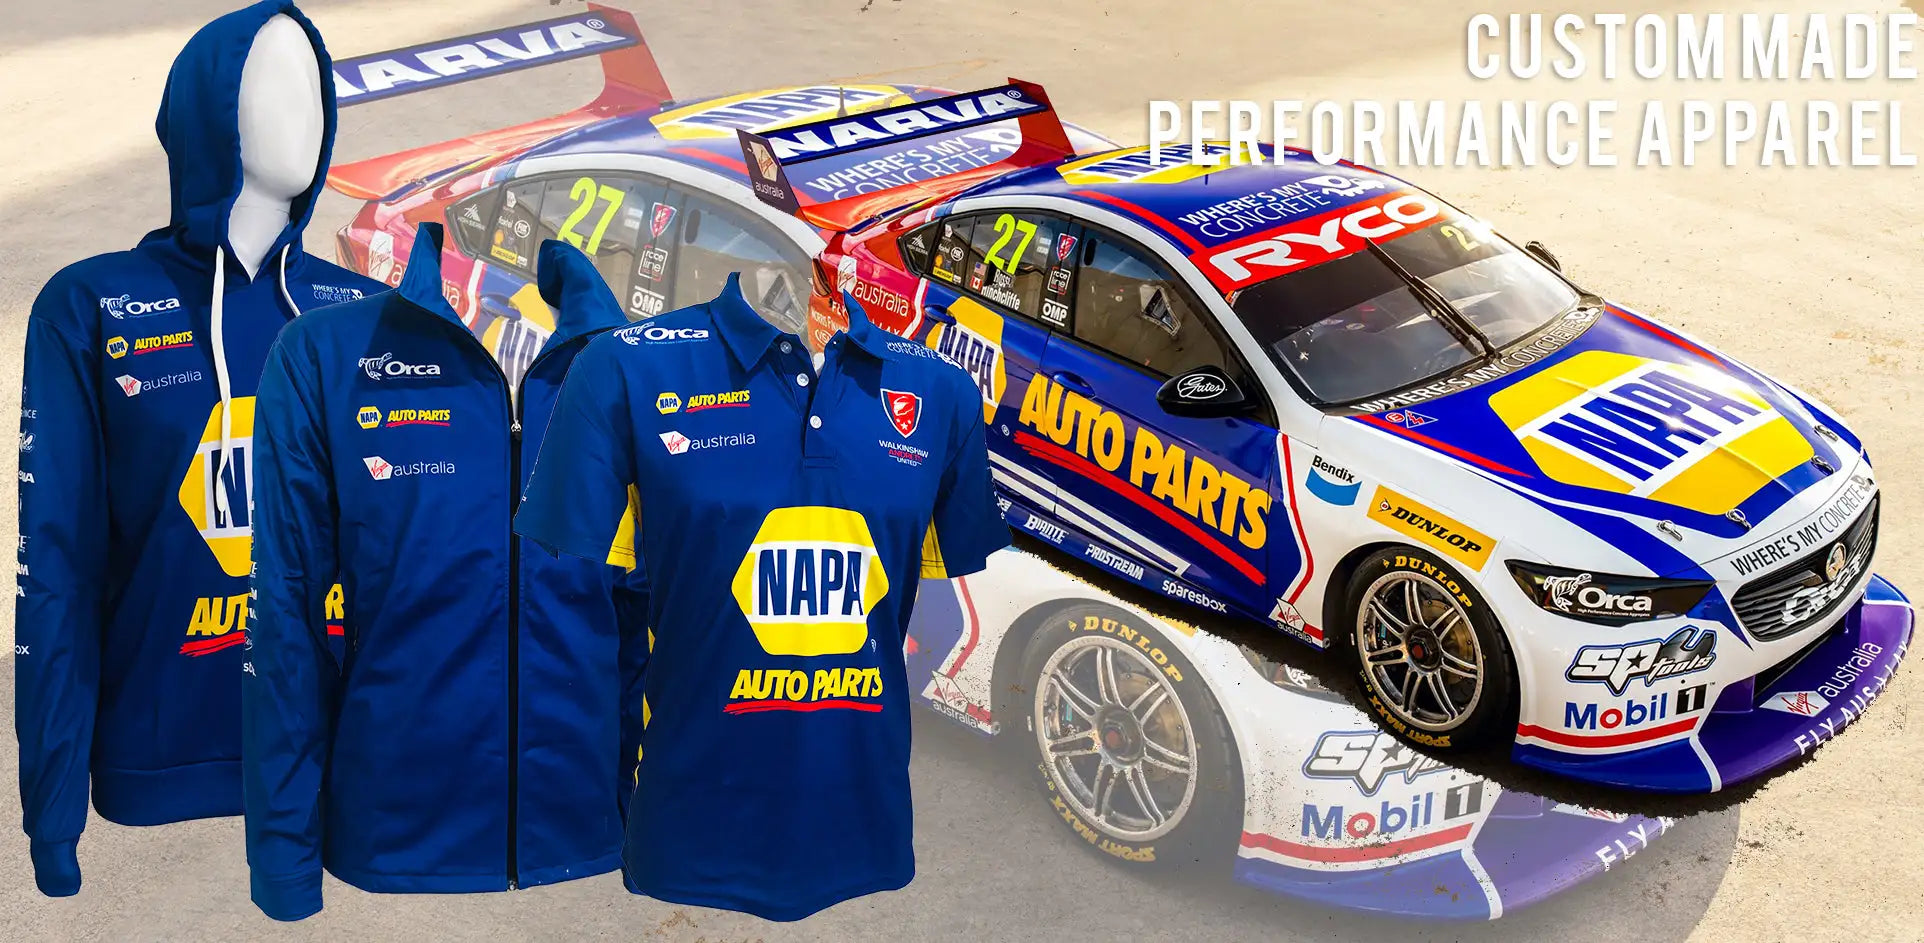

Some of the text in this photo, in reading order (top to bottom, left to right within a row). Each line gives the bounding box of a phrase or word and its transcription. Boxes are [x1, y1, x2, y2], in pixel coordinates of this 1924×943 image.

[805, 136, 972, 192] WHERE'S MY
[755, 180, 785, 200] australia
[1178, 181, 1306, 227] WHERE'S MY
[557, 176, 626, 255] 27
[1199, 191, 1331, 238] CONCRETE
[984, 213, 1038, 274] 27
[1208, 195, 1440, 282] RYCO
[125, 297, 181, 315] Orca
[632, 291, 664, 315] OMP
[855, 281, 909, 317] australia
[1042, 302, 1068, 322] OMP
[108, 331, 193, 355] NAPA AUTO PARTS
[643, 327, 709, 341] Orca
[142, 371, 202, 391] australia
[384, 360, 441, 376] Orca
[1350, 318, 1586, 413] WHERE'S MY CONCRETE
[360, 409, 451, 424] NAPA AUTO PARTS
[659, 390, 751, 409] NAPA AUTO PARTS
[691, 432, 756, 451] australia
[1538, 370, 1762, 482] NAPA
[878, 439, 929, 459] WALKINSHAW
[1018, 372, 1273, 551] AUTO PARTS
[393, 461, 456, 477] australia
[1311, 454, 1355, 484] Bendix
[1391, 506, 1482, 553] DUNLOP
[1730, 483, 1866, 577] WHERE'S MY CONCRETE
[758, 548, 864, 617] NAPA
[1394, 555, 1473, 609] DUNLOP
[1577, 587, 1653, 612] Orca
[186, 592, 252, 636] AUT
[1276, 620, 1313, 644] australia
[1083, 615, 1184, 682] DUNLOP
[729, 666, 884, 702] AUTO PARTS
[1817, 642, 1884, 698] australia
[932, 701, 978, 729] australia
[1564, 692, 1668, 730] Mobil
[1794, 717, 1835, 756] FLY
[1301, 791, 1434, 840] Mobil
